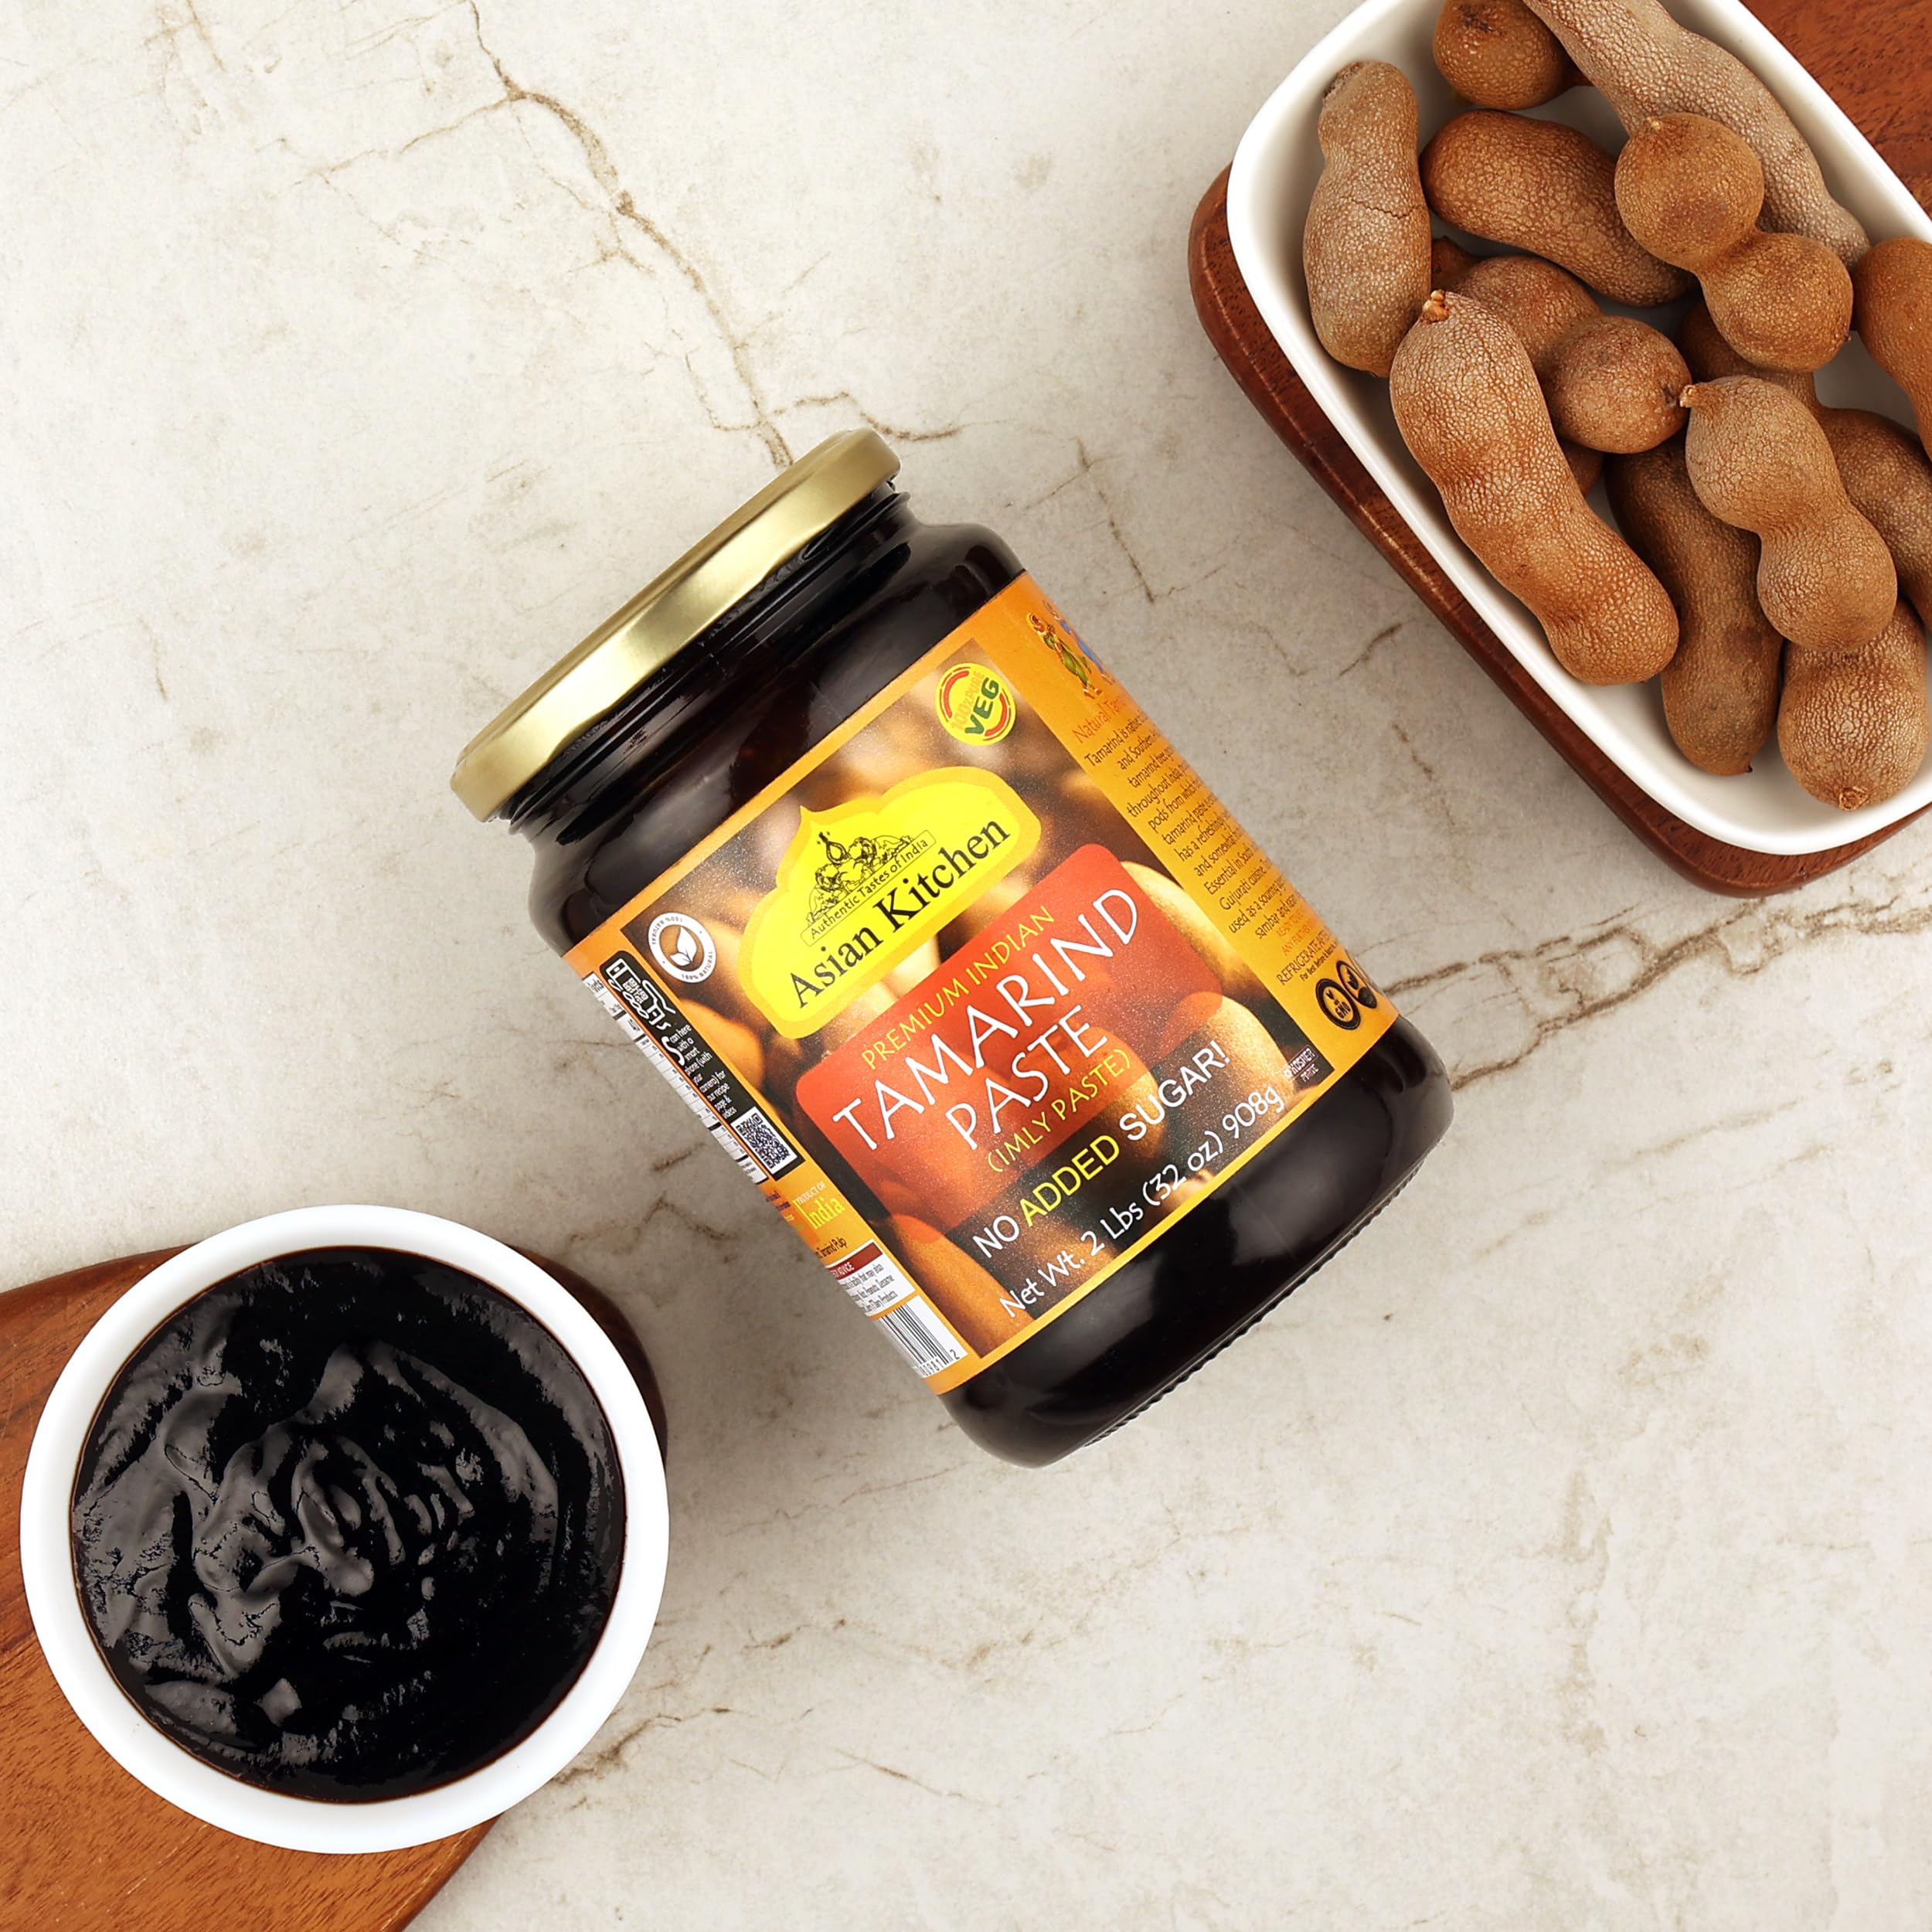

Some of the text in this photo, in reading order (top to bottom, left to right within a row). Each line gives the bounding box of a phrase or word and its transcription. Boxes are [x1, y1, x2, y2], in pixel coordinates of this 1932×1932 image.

[964, 677, 999, 734] VEG
[1072, 703, 1112, 743] Natural
[1084, 730, 1125, 766] Tamarind
[1117, 750, 1135, 770] and
[1128, 754, 1161, 788] tamarind
[1127, 774, 1172, 818] throughout
[1148, 808, 1168, 834] pods
[1163, 796, 1185, 815] from
[1162, 810, 1197, 845] tamarind
[1174, 845, 1194, 861] has
[1190, 841, 1199, 850] a
[1194, 855, 1213, 876] and
[810, 838, 928, 939] Authentic Tastes of India
[1204, 859, 1237, 895] Essential
[1232, 859, 1244, 869] in
[1219, 879, 1251, 910] Gujurati
[790, 821, 1011, 1009] Asian Kitchen
[1229, 908, 1250, 934] used
[1246, 906, 1257, 917] as
[1253, 901, 1262, 910] a
[1255, 913, 1280, 939] sambar
[1277, 939, 1320, 986] REFRIGERATE
[862, 906, 1055, 1070] PREMIUM INDIAN
[675, 1025, 692, 1036] here
[832, 889, 1138, 1150] TAMARIND
[715, 1070, 726, 1080] for
[945, 1005, 1107, 1150] PASTE
[988, 1049, 1131, 1172] (IMLY PASTE)
[973, 1039, 1230, 1258] NO ADDED SUGAR!
[791, 1196, 845, 1230] India
[999, 1084, 1286, 1318] Net Wt. 2 Lbs (32 oz) 908g
[949, 1349, 960, 1360] 2
